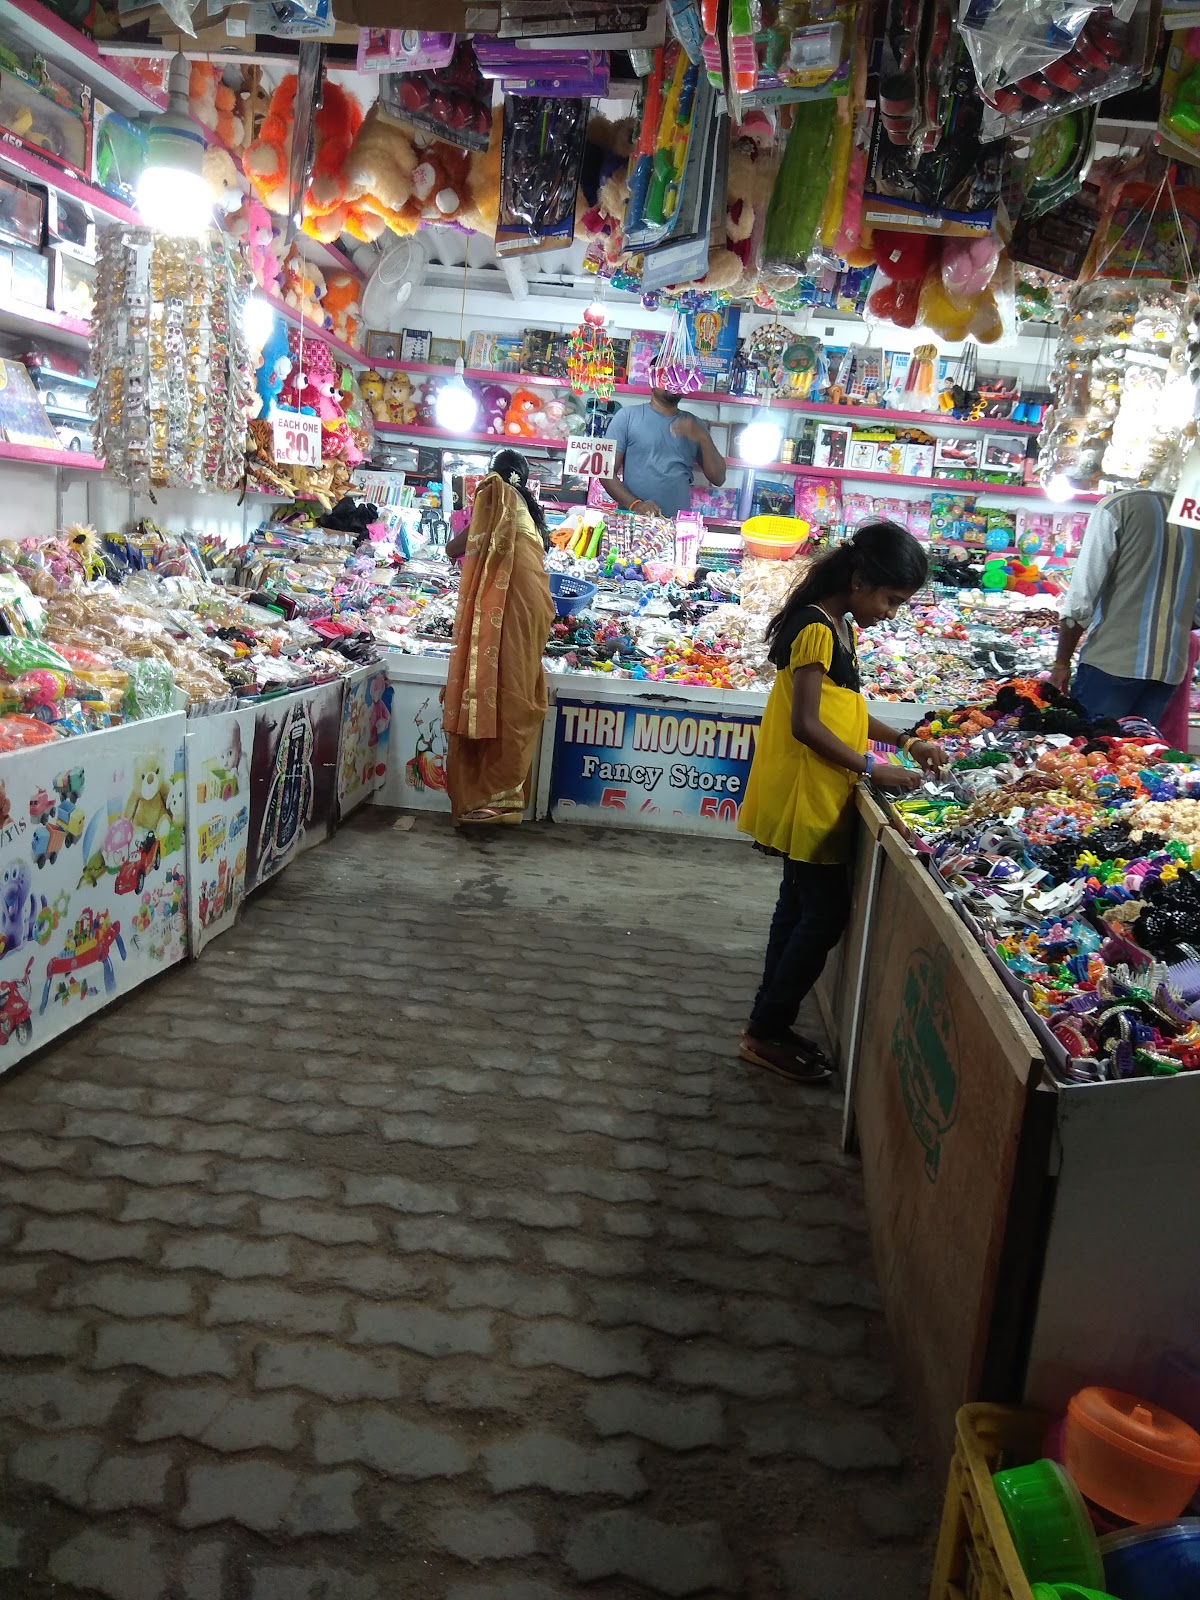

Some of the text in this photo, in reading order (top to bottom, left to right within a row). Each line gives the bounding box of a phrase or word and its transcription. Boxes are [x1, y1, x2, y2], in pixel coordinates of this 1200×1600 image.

[278, 418, 319, 434] EACH ONE
[276, 430, 309, 463] Rs 30
[571, 441, 613, 452] EACH ONE
[568, 451, 603, 476] Rs 20
[563, 706, 625, 748] THRI
[581, 755, 741, 793] Fancy Store
[601, 788, 627, 813] 5
[700, 797, 743, 823] 50
